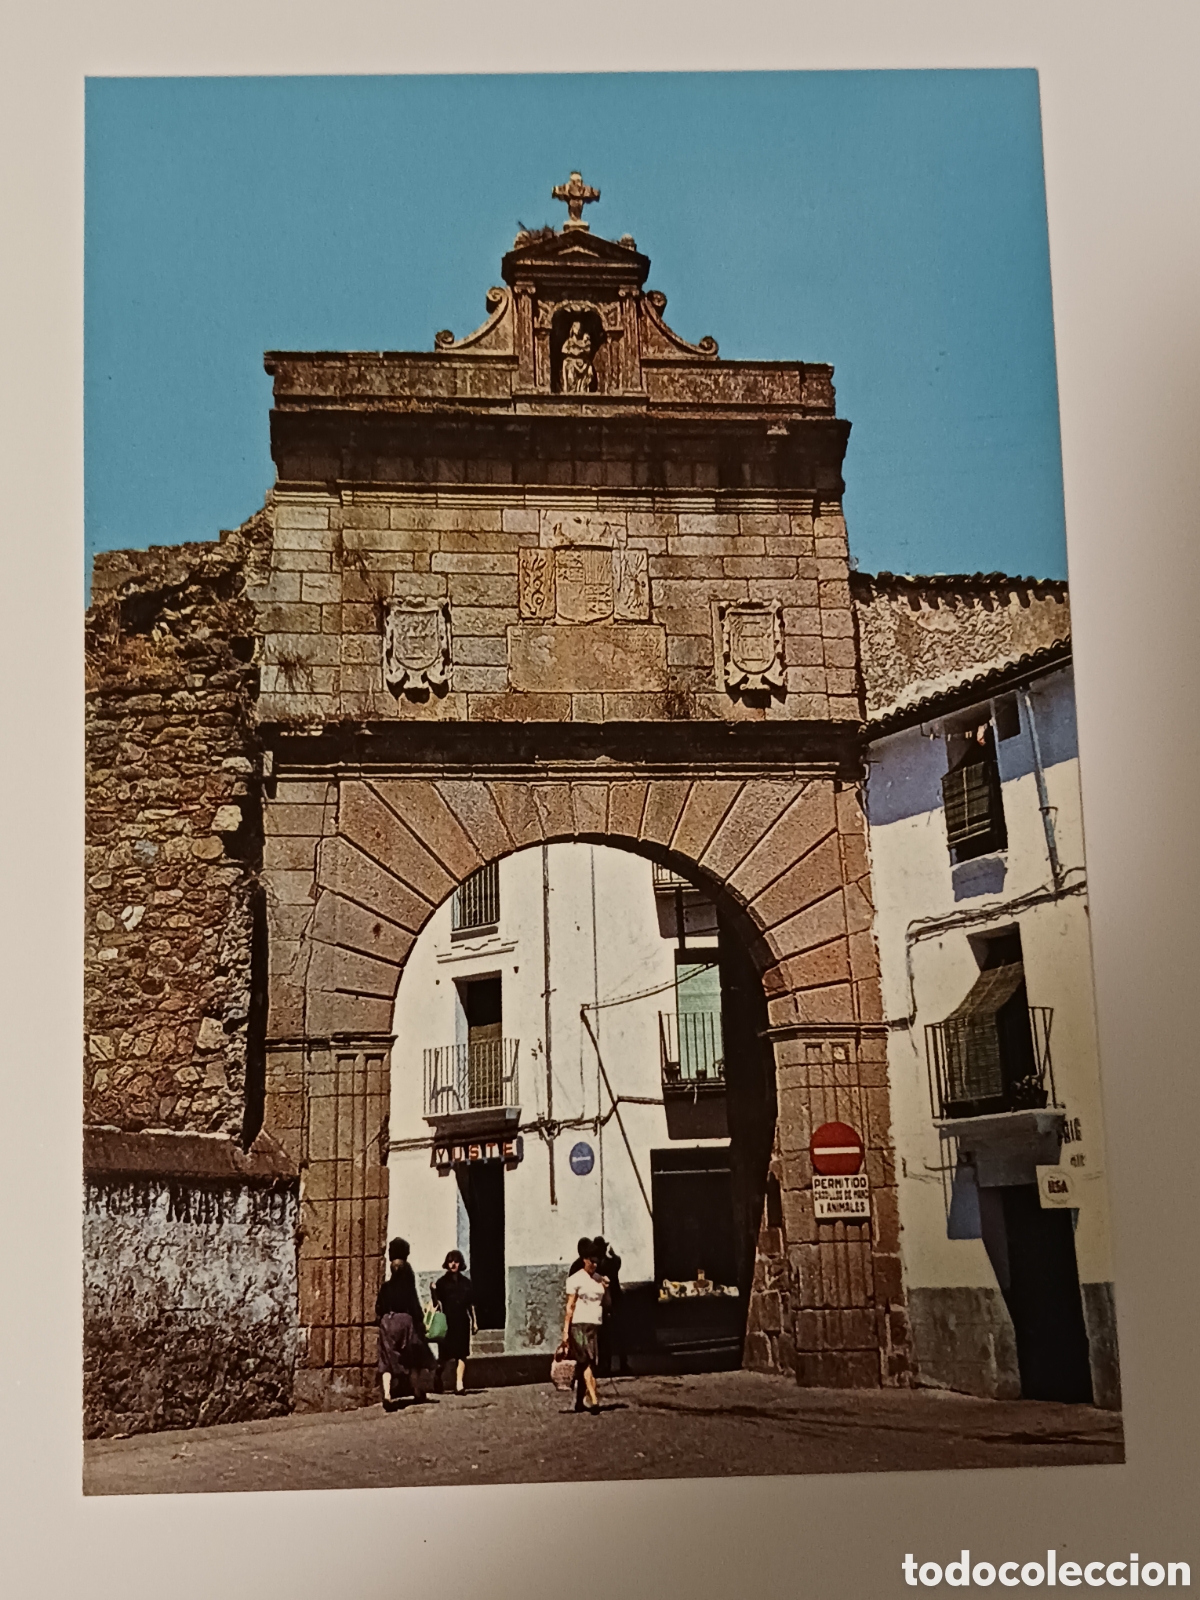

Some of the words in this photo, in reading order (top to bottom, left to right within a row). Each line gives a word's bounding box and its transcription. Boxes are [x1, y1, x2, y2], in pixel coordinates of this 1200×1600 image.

[436, 1142, 514, 1163] YUSTE
[814, 1177, 867, 1189] PERMITIDO
[844, 1189, 852, 1200] DE
[827, 1201, 865, 1213] ANIMALES
